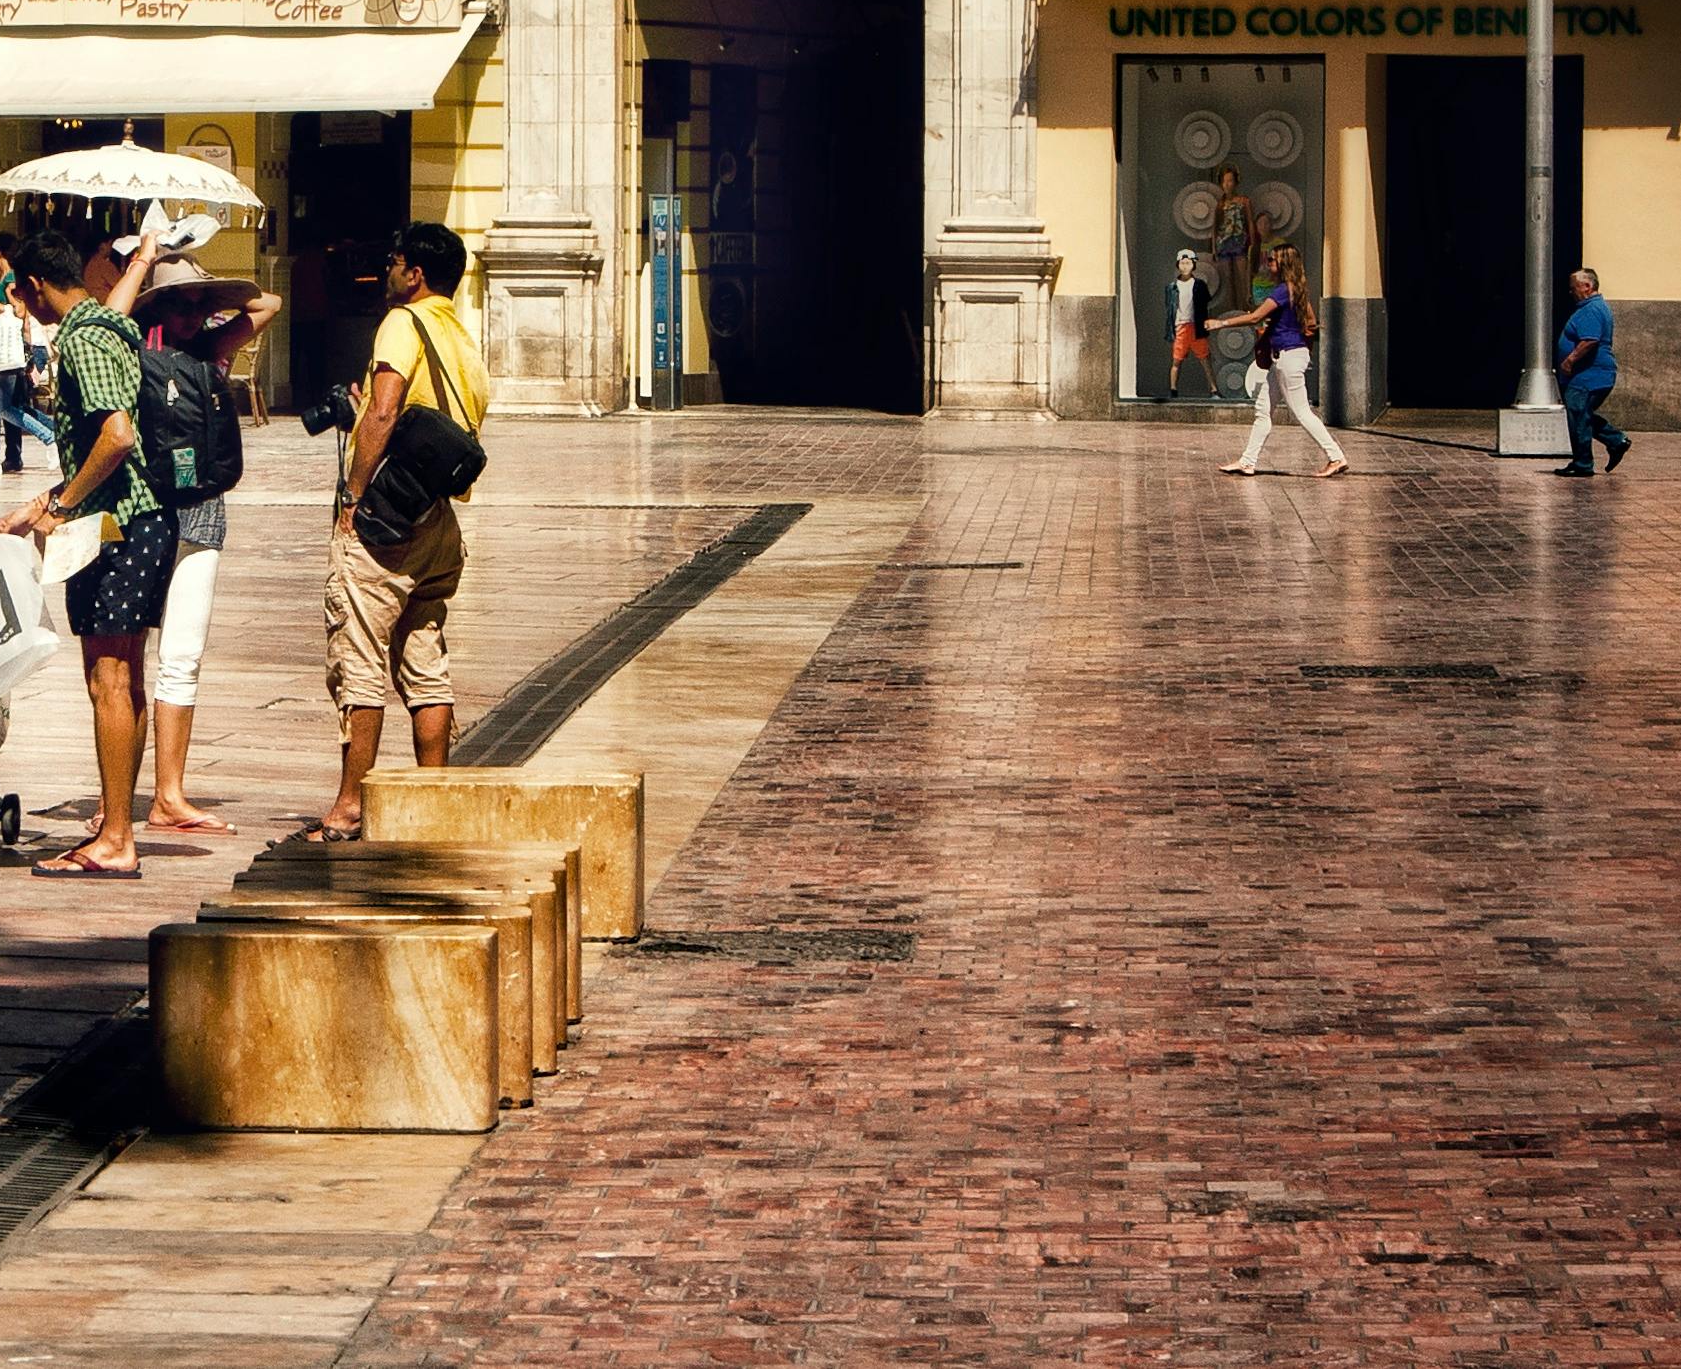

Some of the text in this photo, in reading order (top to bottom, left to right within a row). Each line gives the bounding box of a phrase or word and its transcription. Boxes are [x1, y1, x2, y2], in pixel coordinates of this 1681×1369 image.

[1109, 6, 1643, 37] UNITED COLORS OF BENTON.
